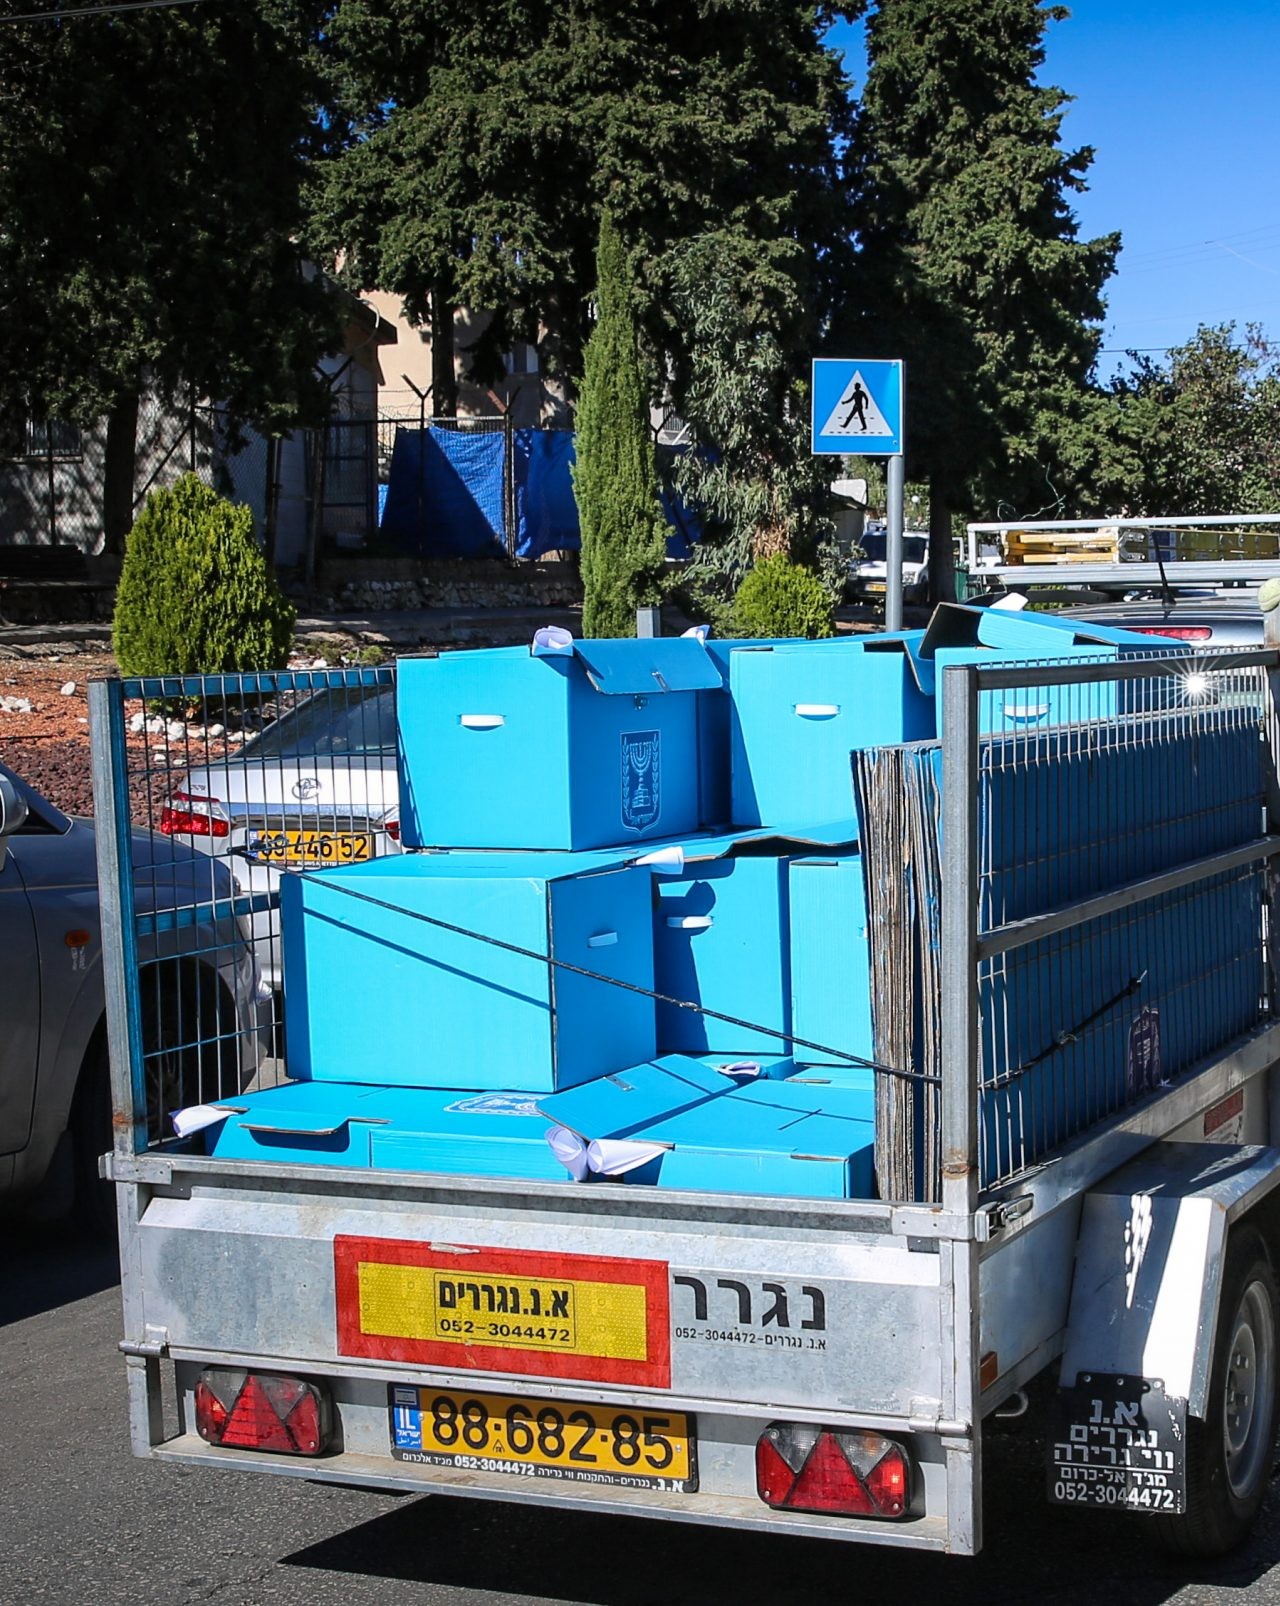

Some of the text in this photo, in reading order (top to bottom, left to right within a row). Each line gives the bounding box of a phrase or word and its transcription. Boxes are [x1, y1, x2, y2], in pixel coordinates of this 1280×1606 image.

[674, 1275, 826, 1331] נגרר
[440, 1319, 570, 1342] 052-3044472
[399, 1405, 416, 1430] IL
[1089, 1399, 1139, 1426] א.נ
[396, 1429, 421, 1438] ישראל
[1070, 1424, 1158, 1448] נגררים
[454, 1454, 535, 1476] 052-3044472
[1054, 1443, 1174, 1469] ווי גרירה
[1054, 1481, 1174, 1508] 052-3044472
